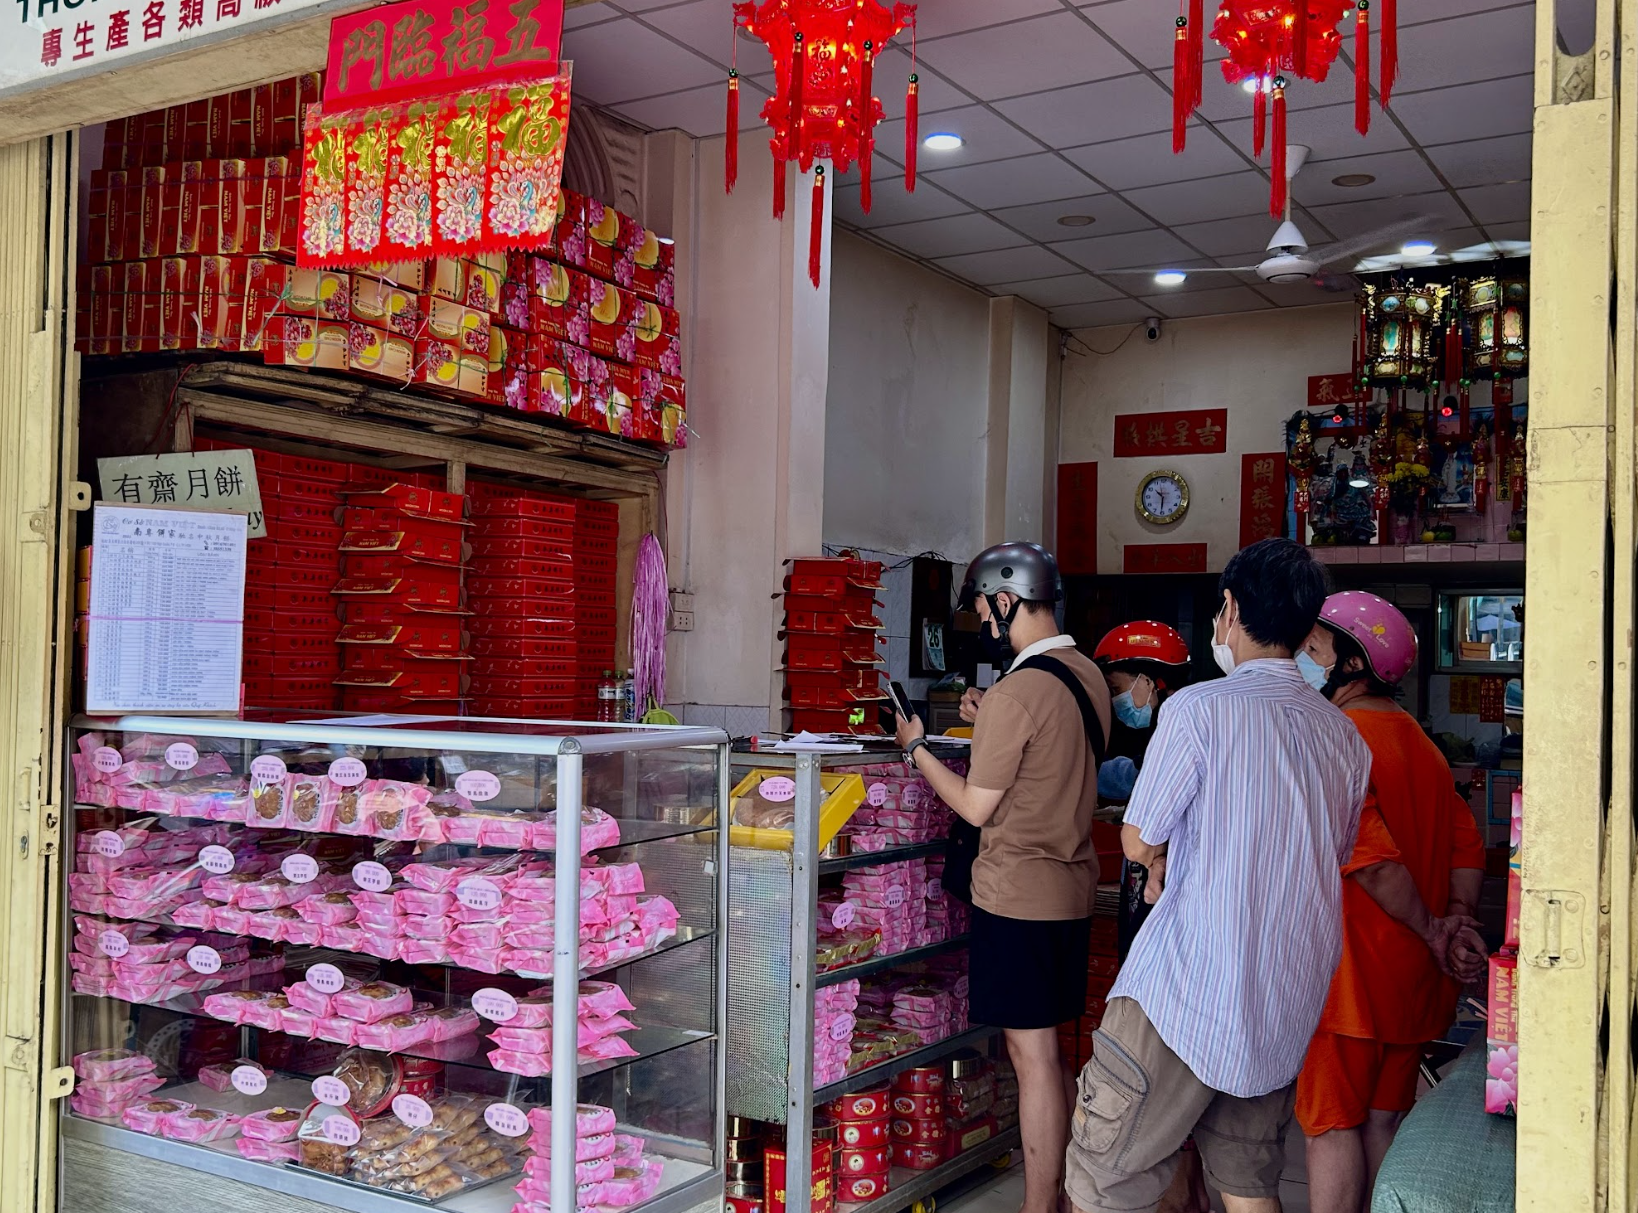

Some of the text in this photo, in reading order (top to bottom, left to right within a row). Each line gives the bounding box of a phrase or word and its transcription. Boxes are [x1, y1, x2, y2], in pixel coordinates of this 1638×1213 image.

[928, 624, 940, 648] 26
[1492, 966, 1512, 1041] NAM VIỆT
